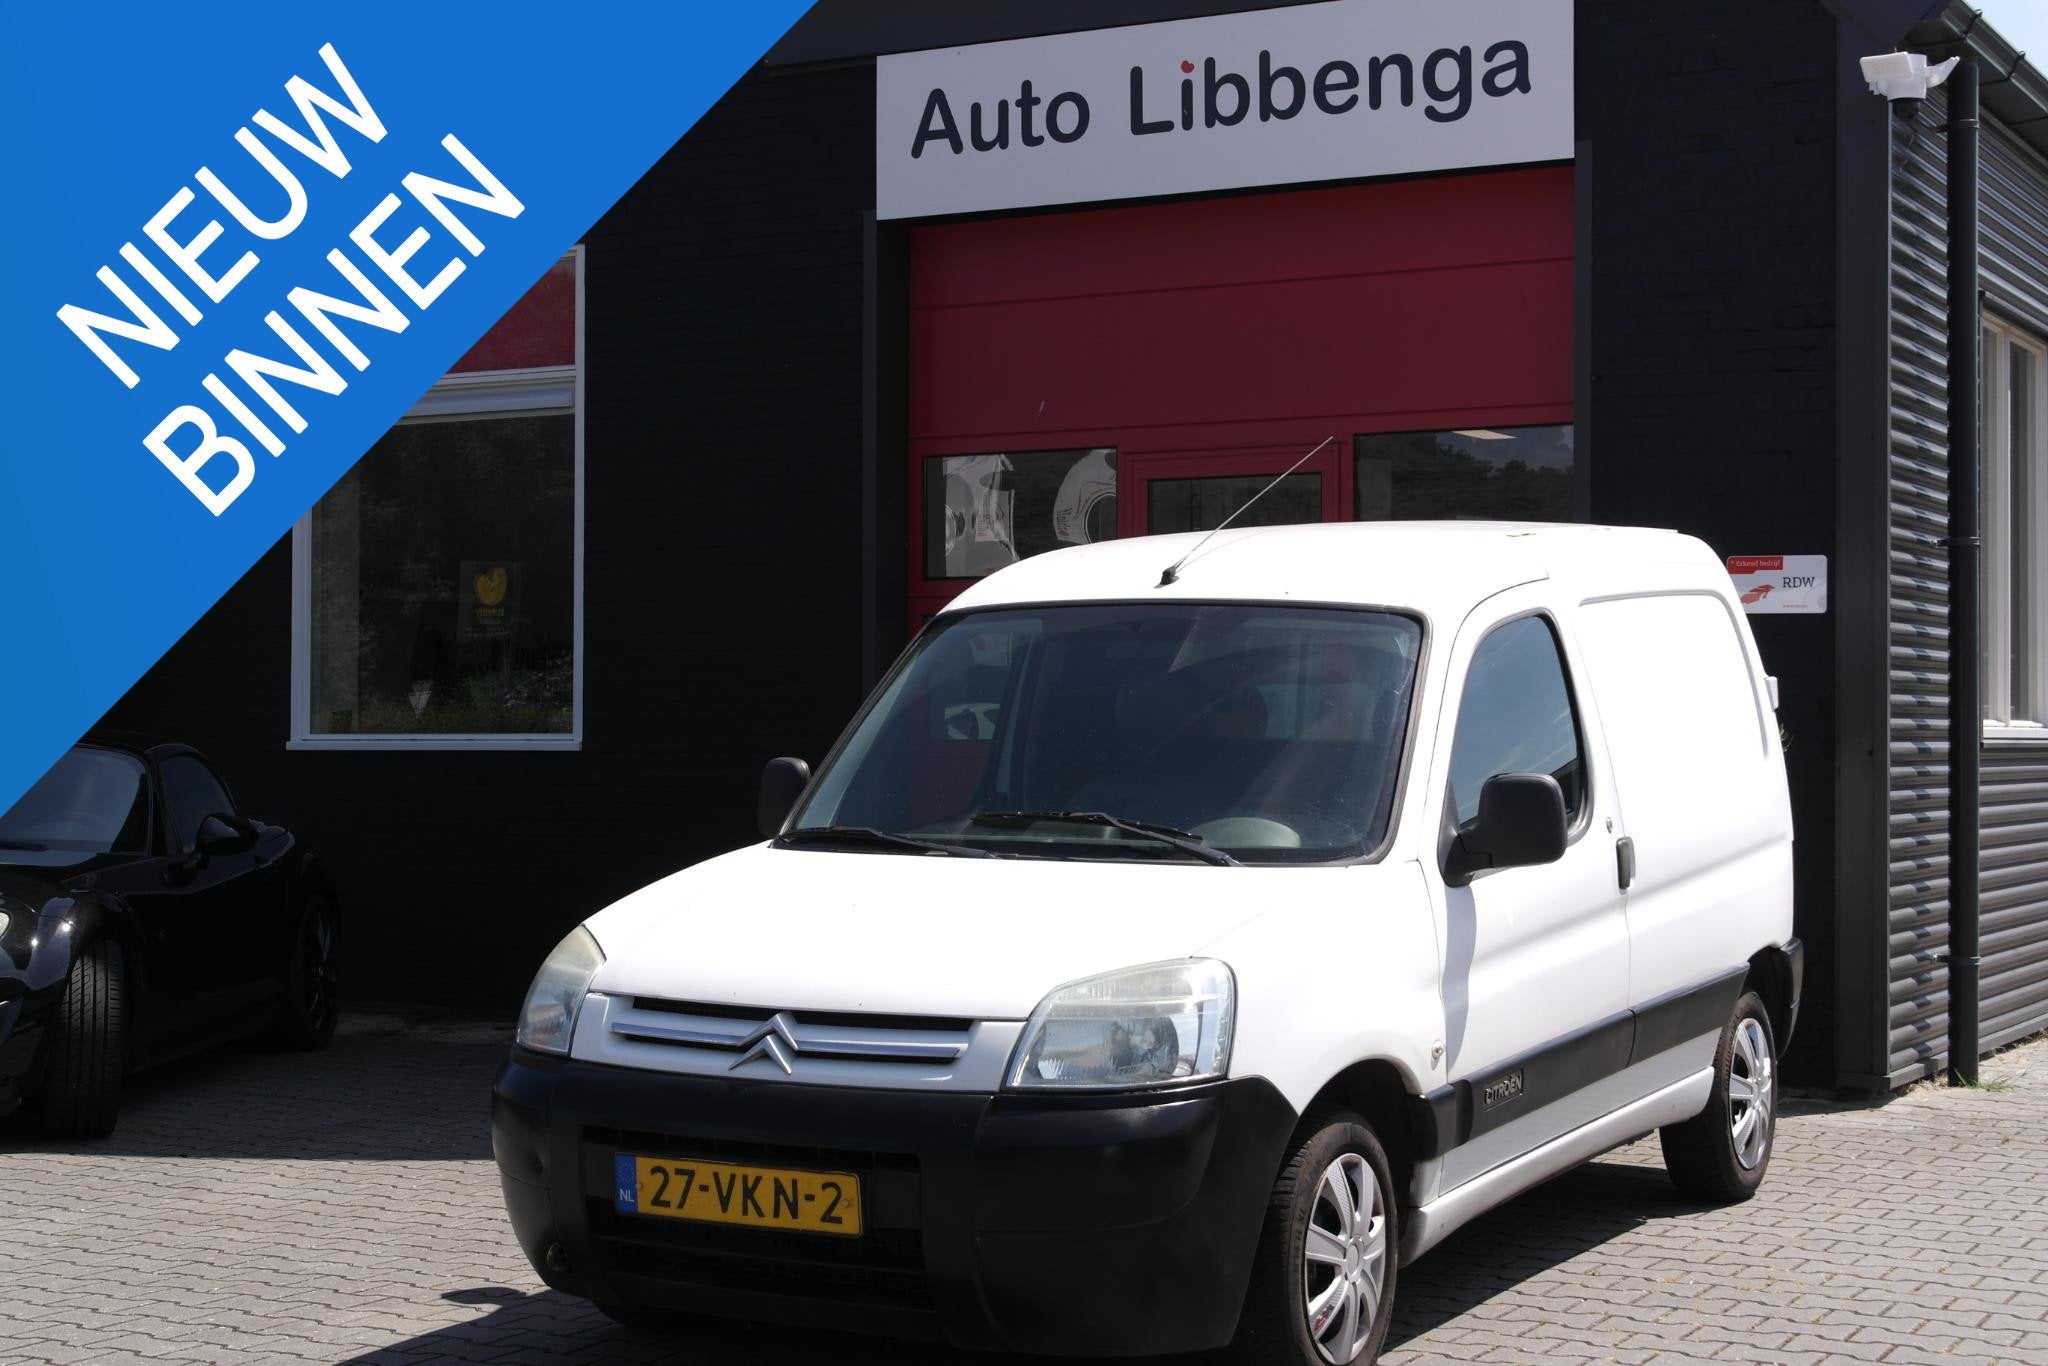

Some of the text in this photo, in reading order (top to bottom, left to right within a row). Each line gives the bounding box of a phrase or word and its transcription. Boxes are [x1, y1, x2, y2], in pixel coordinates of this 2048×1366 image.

[911, 39, 1532, 160] Auto Libbenga
[1782, 576, 1816, 589] RDW
[619, 1188, 635, 1203] NL
[649, 1165, 843, 1225] 27-VKN-2
